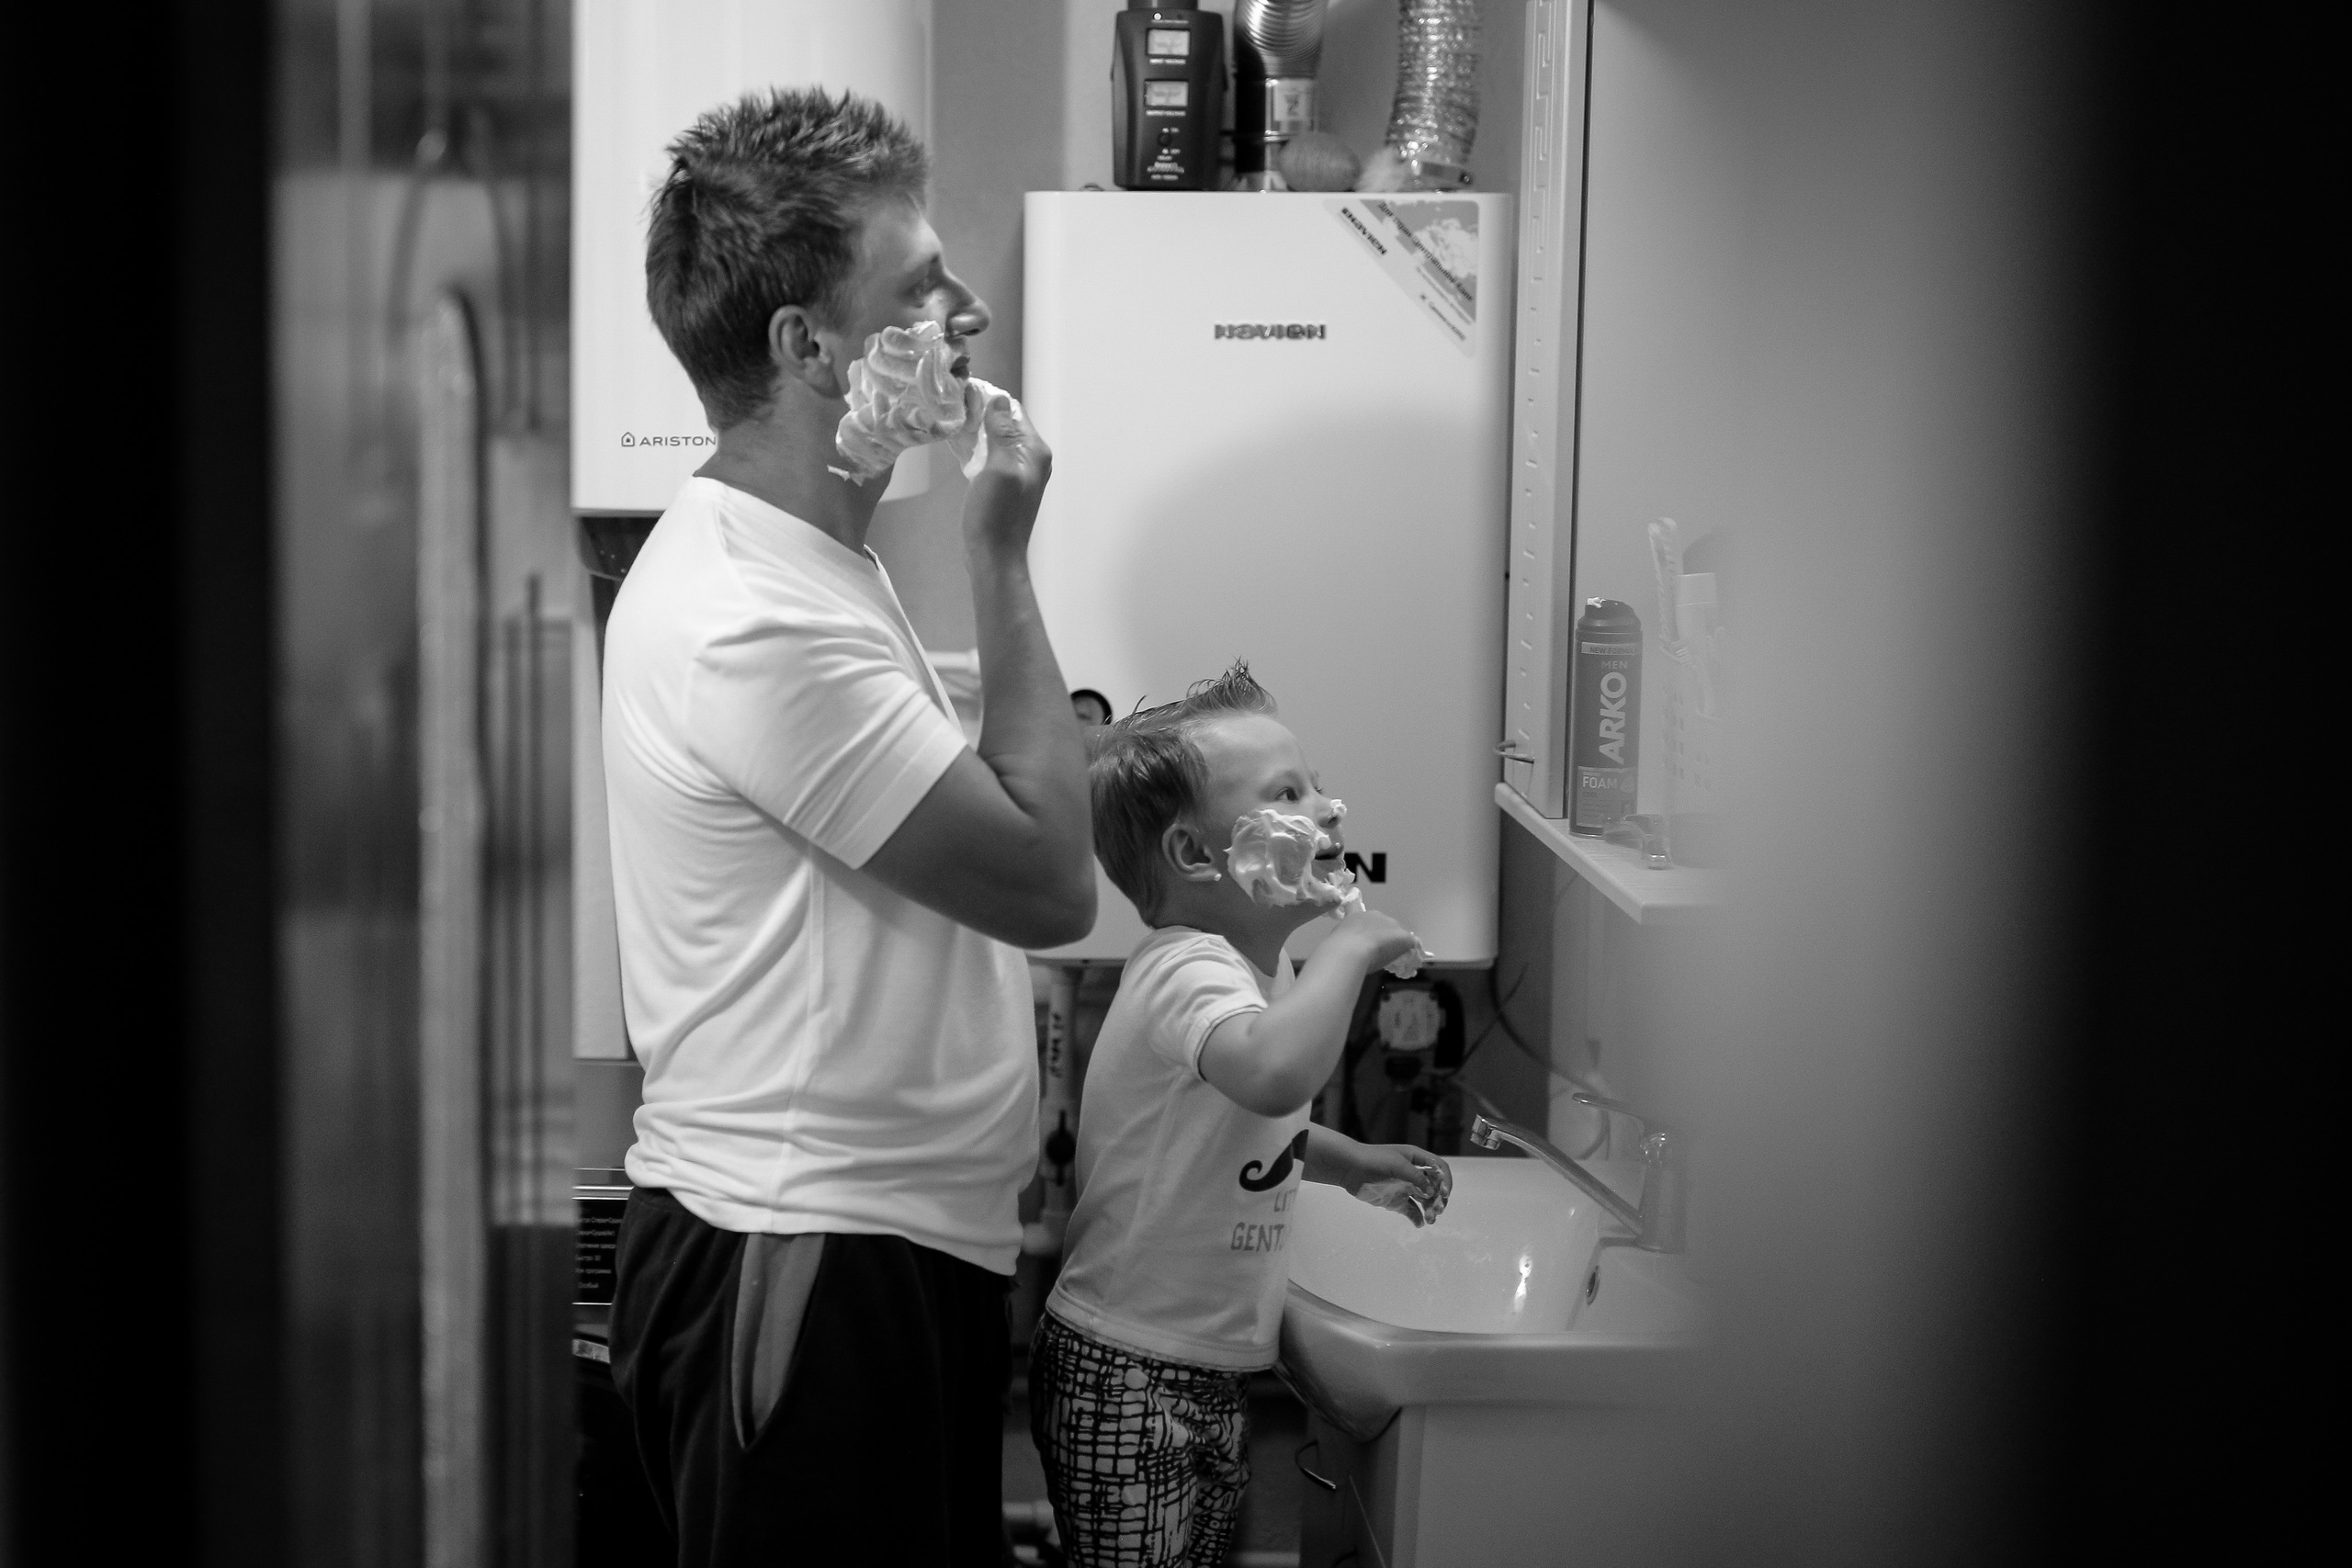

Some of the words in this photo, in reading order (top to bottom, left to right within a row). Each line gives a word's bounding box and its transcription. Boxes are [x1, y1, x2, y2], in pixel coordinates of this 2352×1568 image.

[639, 436, 717, 446] ARISTON
[1601, 660, 1627, 670] MEN
[1599, 671, 1627, 765] ARKO
[1582, 776, 1618, 789] FOAM
[1230, 1222, 1285, 1252] GENT
